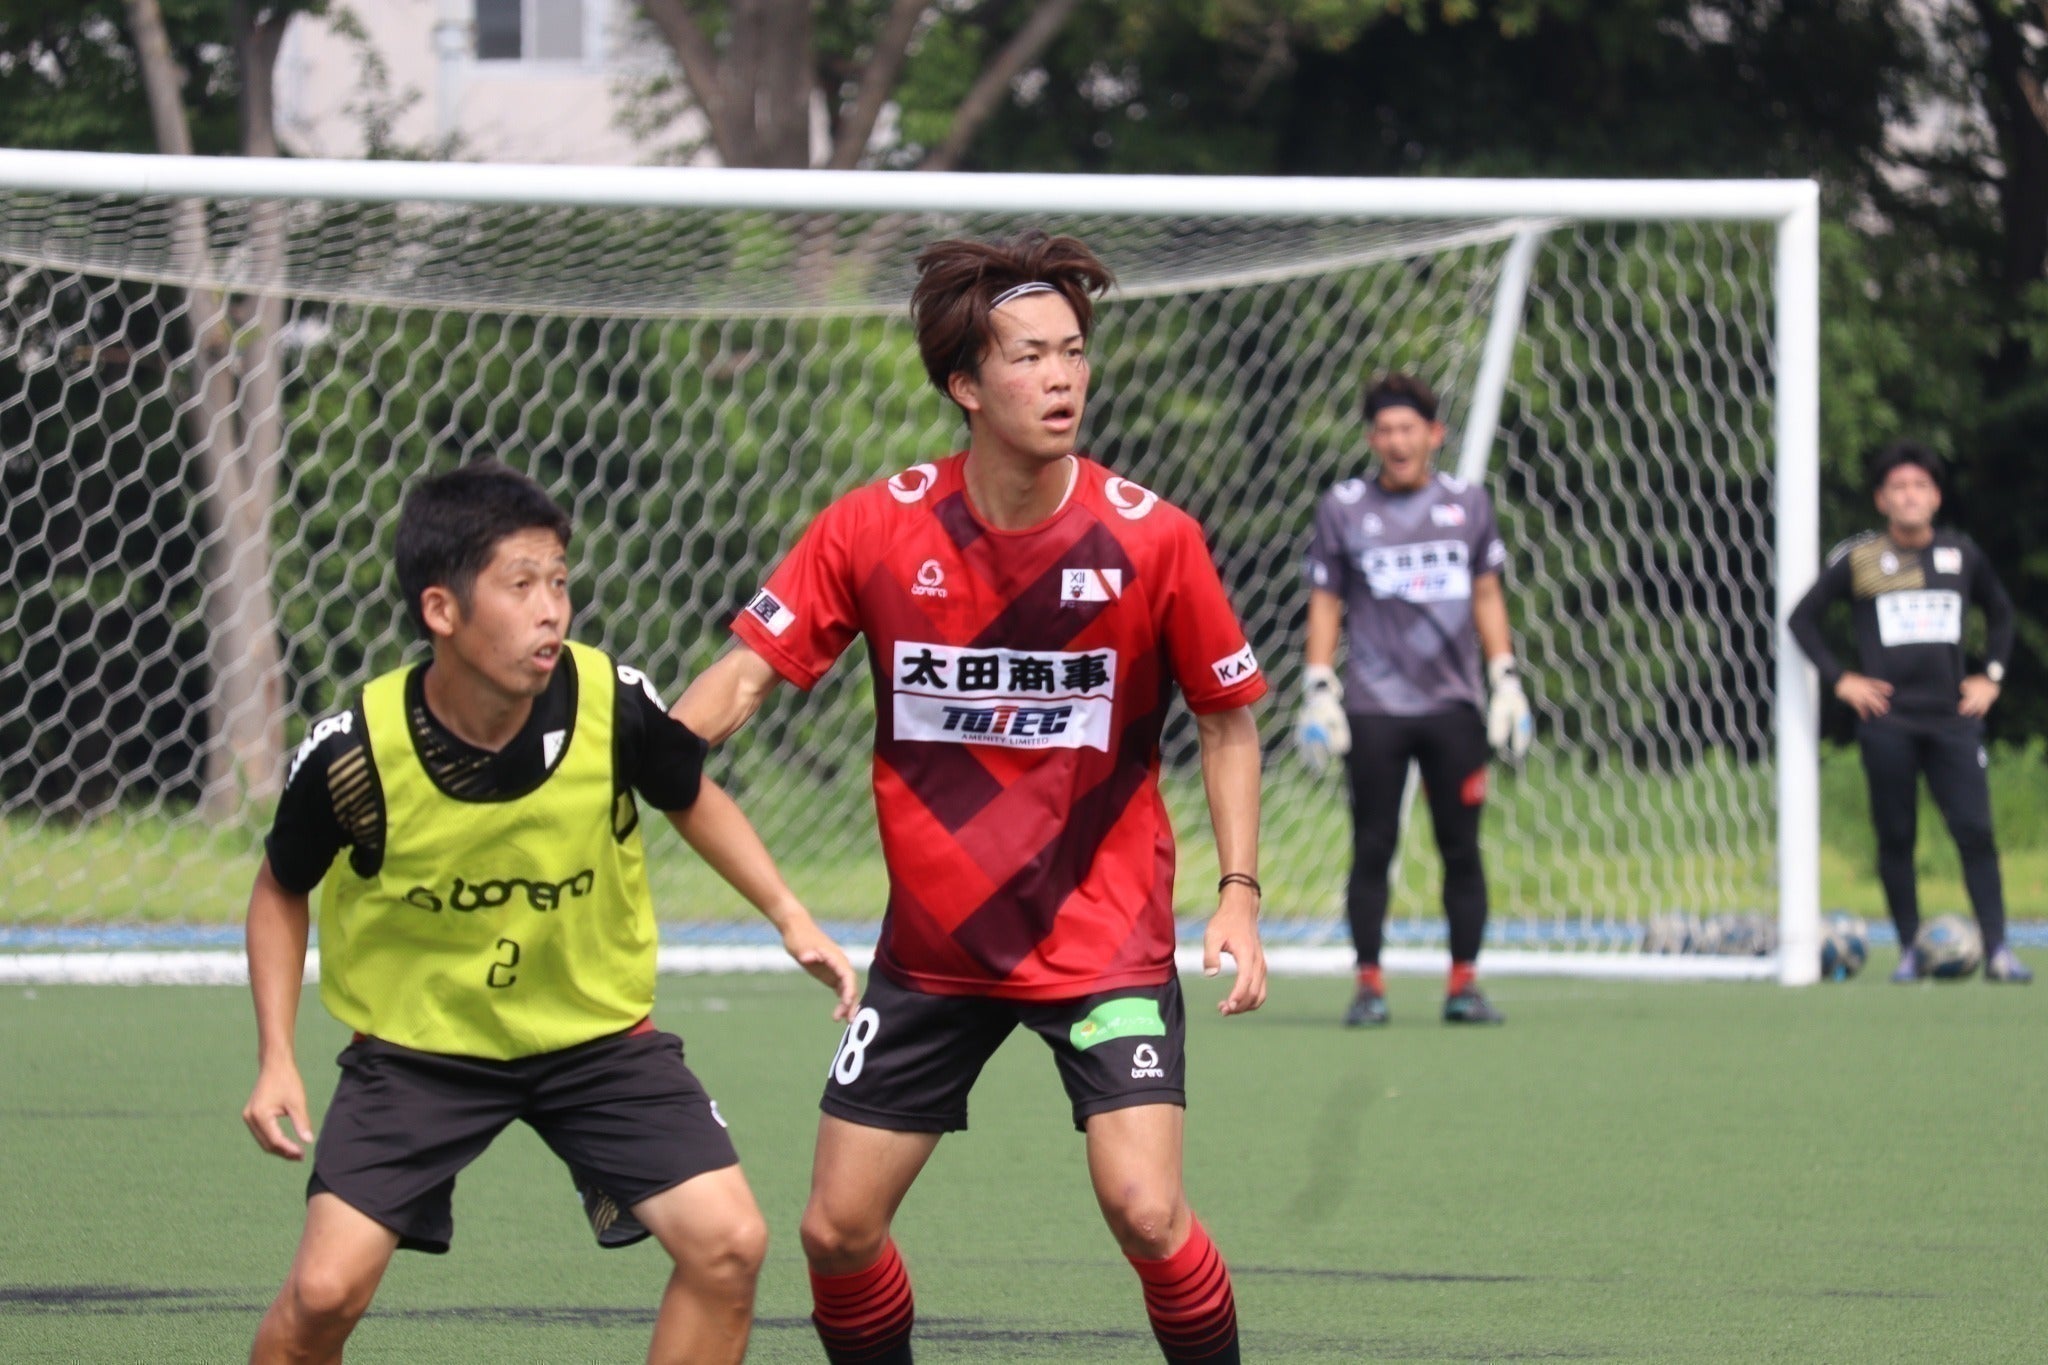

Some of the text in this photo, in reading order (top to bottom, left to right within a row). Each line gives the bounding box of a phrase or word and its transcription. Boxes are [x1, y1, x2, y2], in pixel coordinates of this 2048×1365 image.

[747, 590, 781, 624] 屋
[901, 648, 1110, 694] 太田商事
[942, 705, 1073, 737] TOTEC
[961, 733, 1049, 746] AMENITY LIMITED
[486, 937, 520, 988] 2
